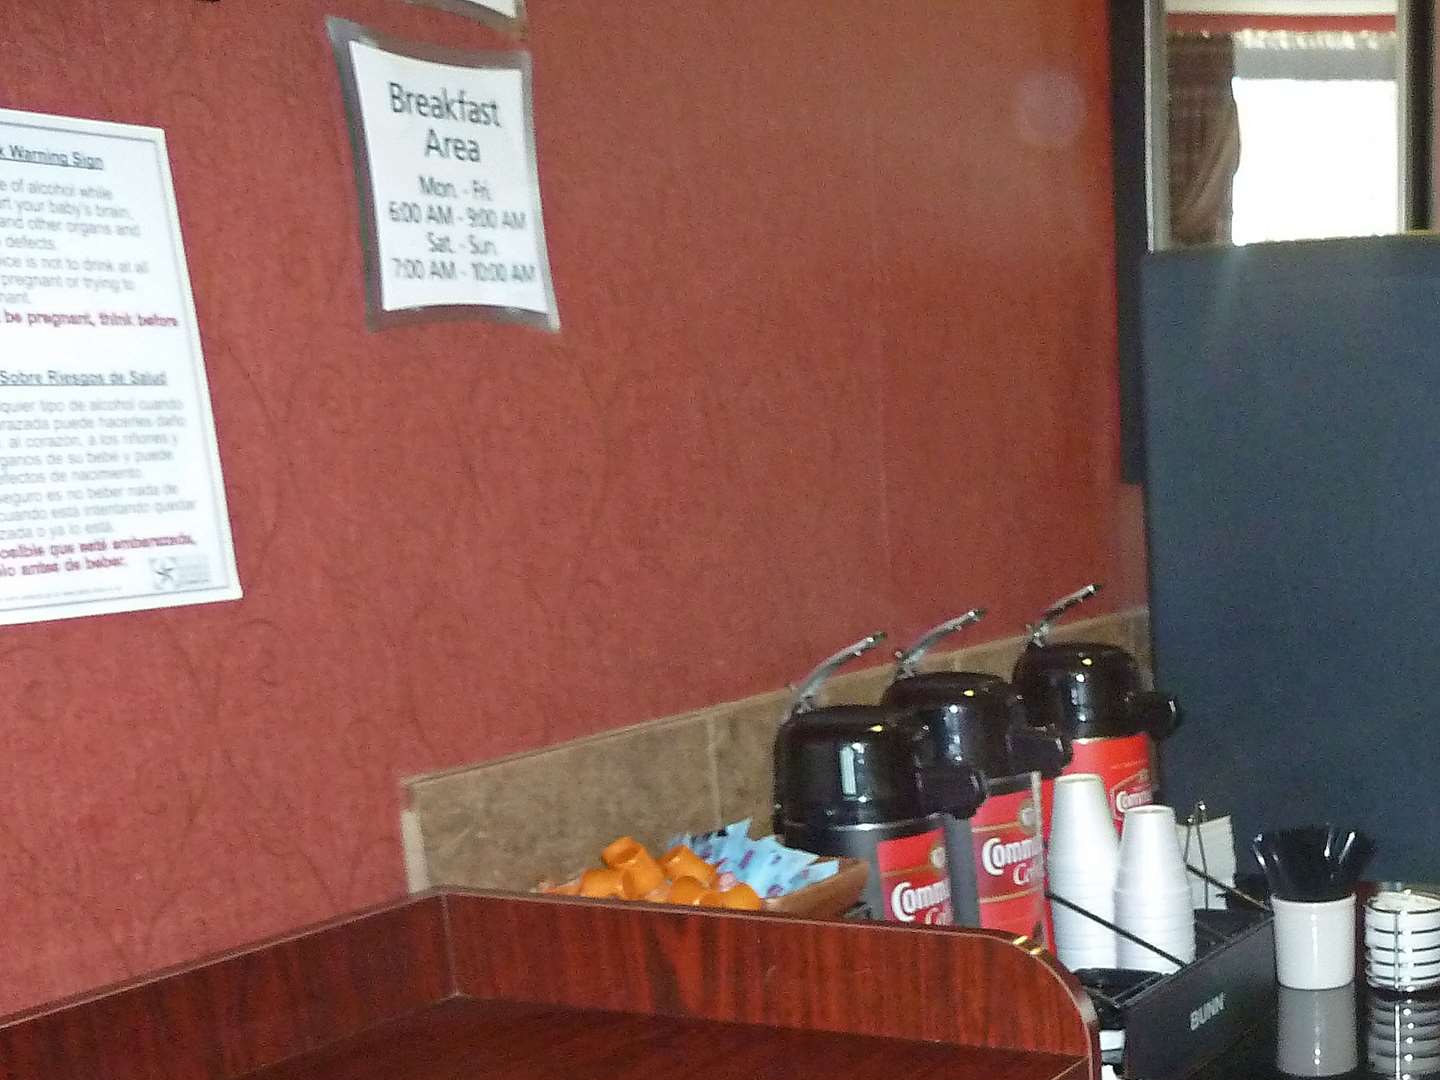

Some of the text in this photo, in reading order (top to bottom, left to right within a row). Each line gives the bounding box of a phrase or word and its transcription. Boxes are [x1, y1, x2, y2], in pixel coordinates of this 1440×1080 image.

[388, 81, 502, 128] Breakfast
[8, 145, 69, 168] Warning
[71, 150, 105, 171] Sign
[424, 128, 482, 163] Area
[27, 181, 75, 197] alcohol
[426, 204, 455, 225] AM
[502, 211, 528, 230] AM
[428, 260, 457, 281] AM
[510, 264, 536, 285] AM
[4, 307, 23, 324] be
[0, 369, 43, 386] Sobre
